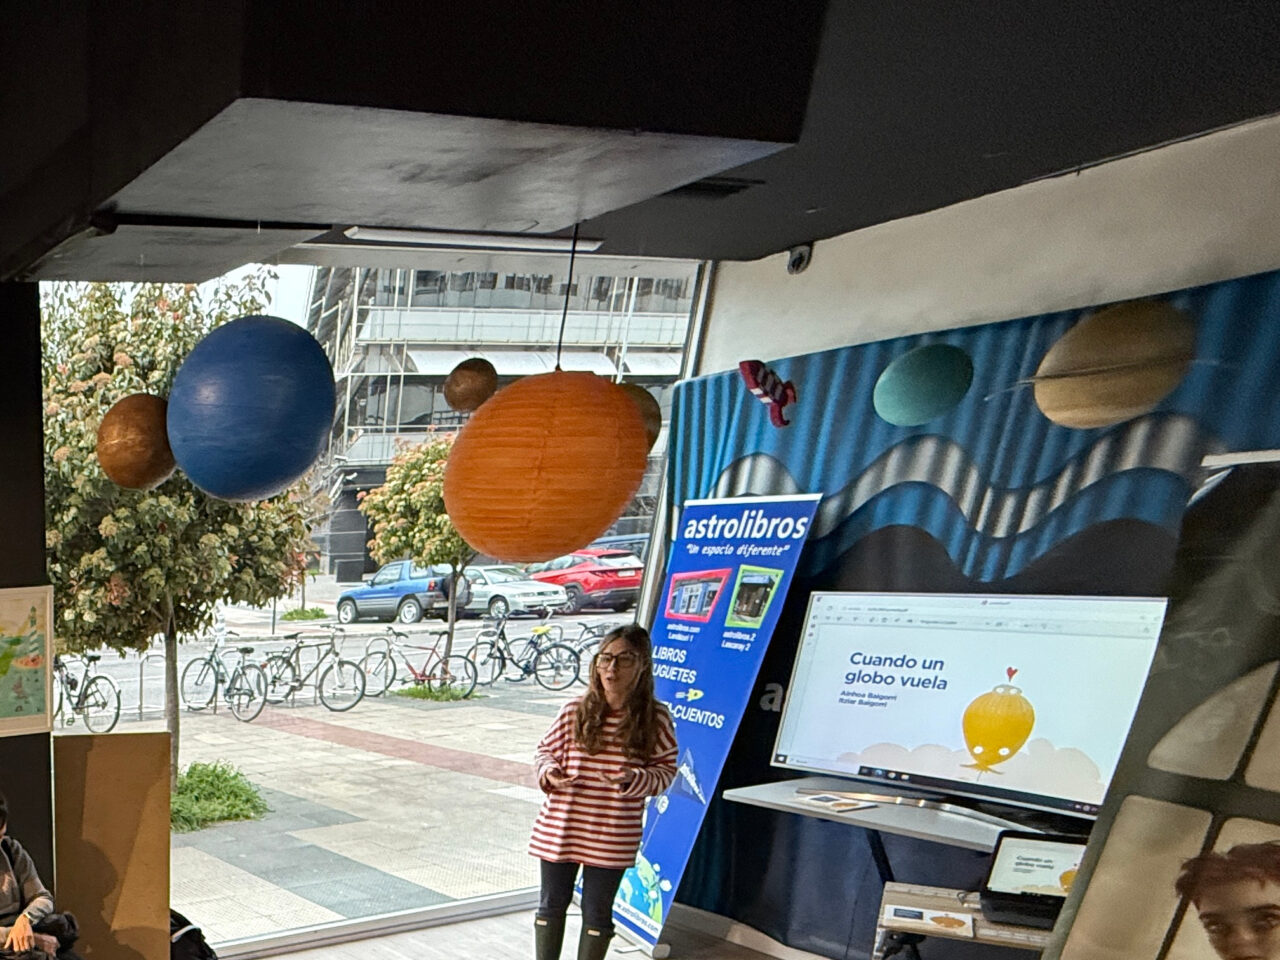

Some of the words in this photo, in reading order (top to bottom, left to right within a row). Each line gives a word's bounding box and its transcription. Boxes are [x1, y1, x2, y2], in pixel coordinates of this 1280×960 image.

[683, 509, 809, 540] astrolibros
[701, 544, 734, 557] espacio
[651, 645, 687, 664] LIBROS
[849, 651, 918, 670] Cuando
[921, 657, 945, 671] un
[652, 664, 697, 684] UGUETES
[844, 669, 897, 690] globo
[899, 674, 948, 691] vuela
